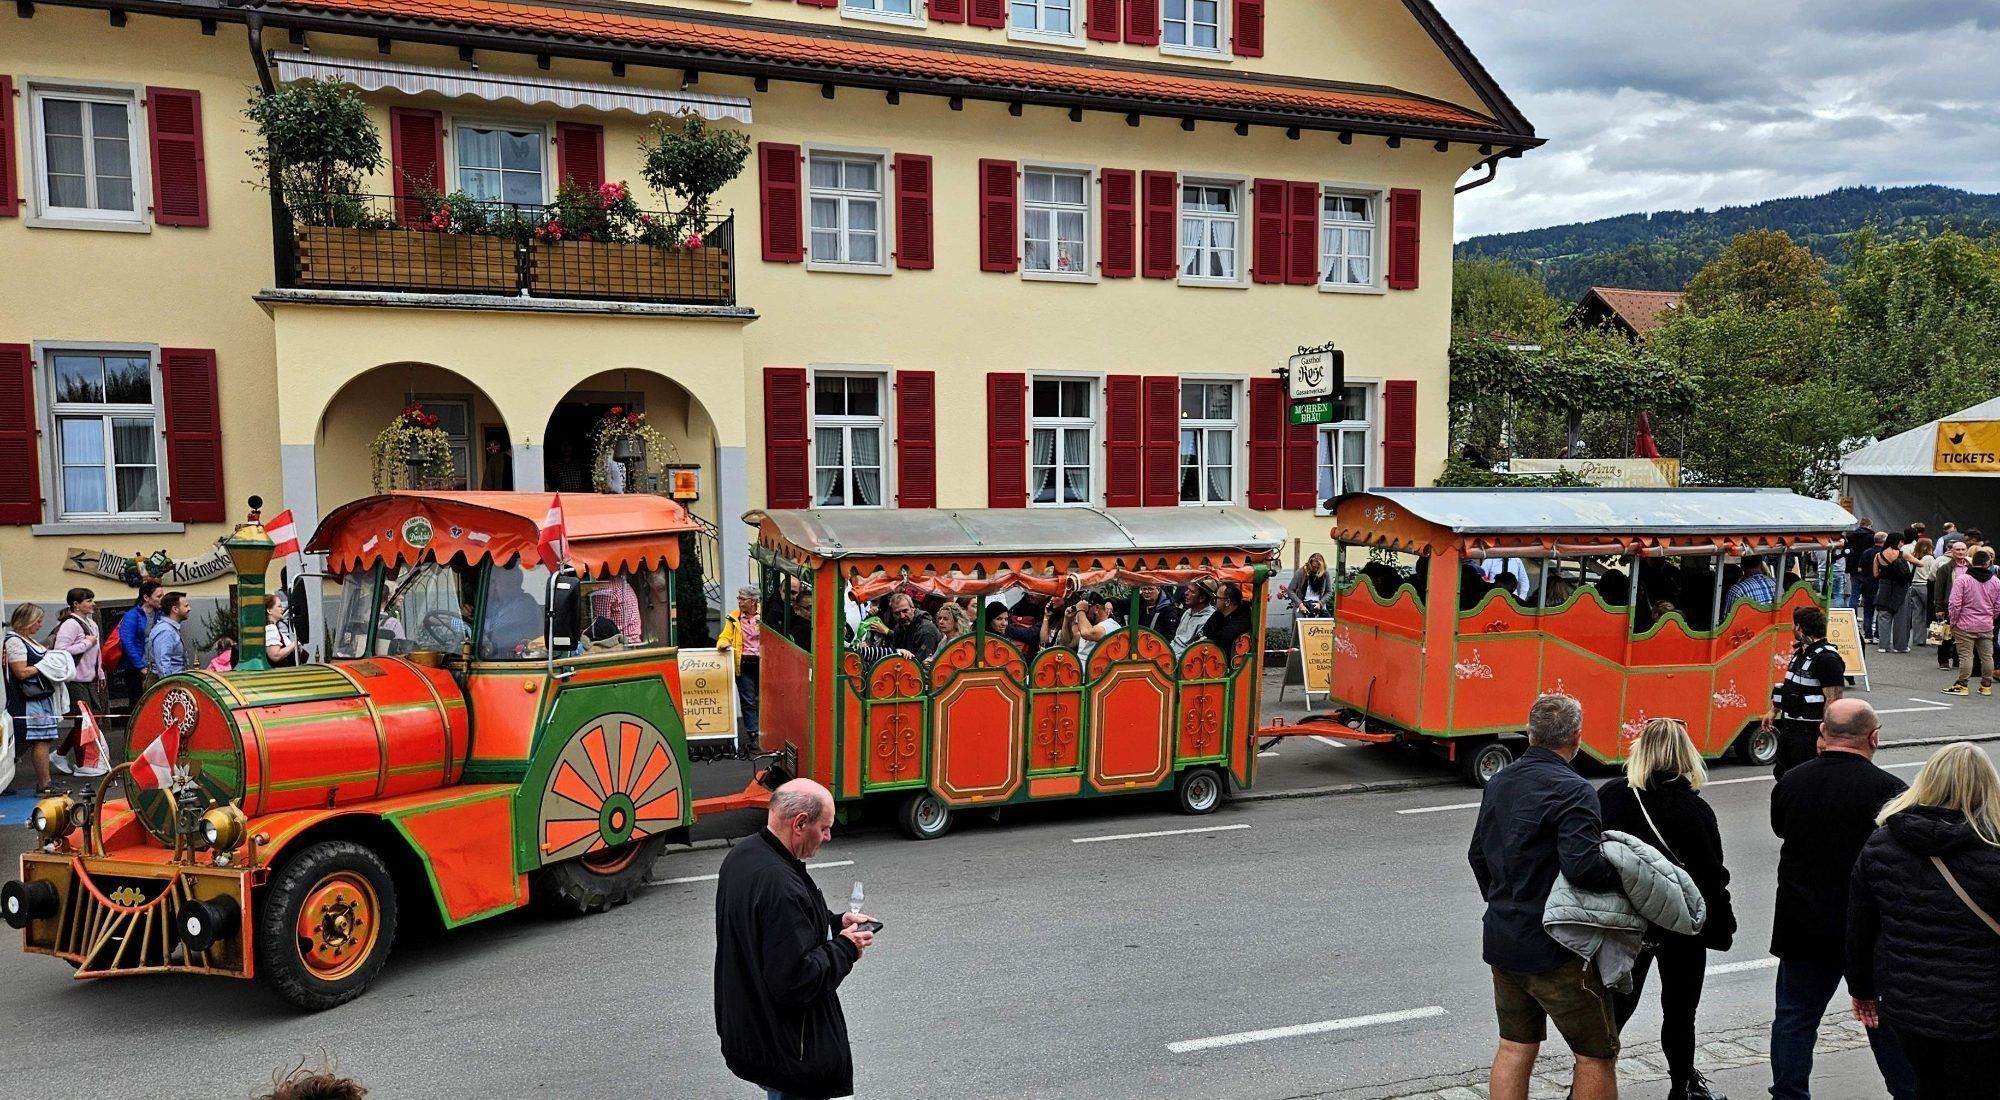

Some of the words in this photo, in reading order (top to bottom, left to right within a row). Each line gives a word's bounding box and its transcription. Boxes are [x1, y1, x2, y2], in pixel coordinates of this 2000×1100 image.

[1301, 355, 1321, 365] Gasthof
[1301, 411, 1320, 422] BRÄU
[1942, 453, 1994, 463] TICKETS
[1580, 461, 1622, 478] Prinz
[172, 552, 232, 582] Kleinverka
[680, 658, 720, 671] Prinz
[686, 698, 719, 706] HAFEN-
[683, 707, 723, 715] SHUTTLE
